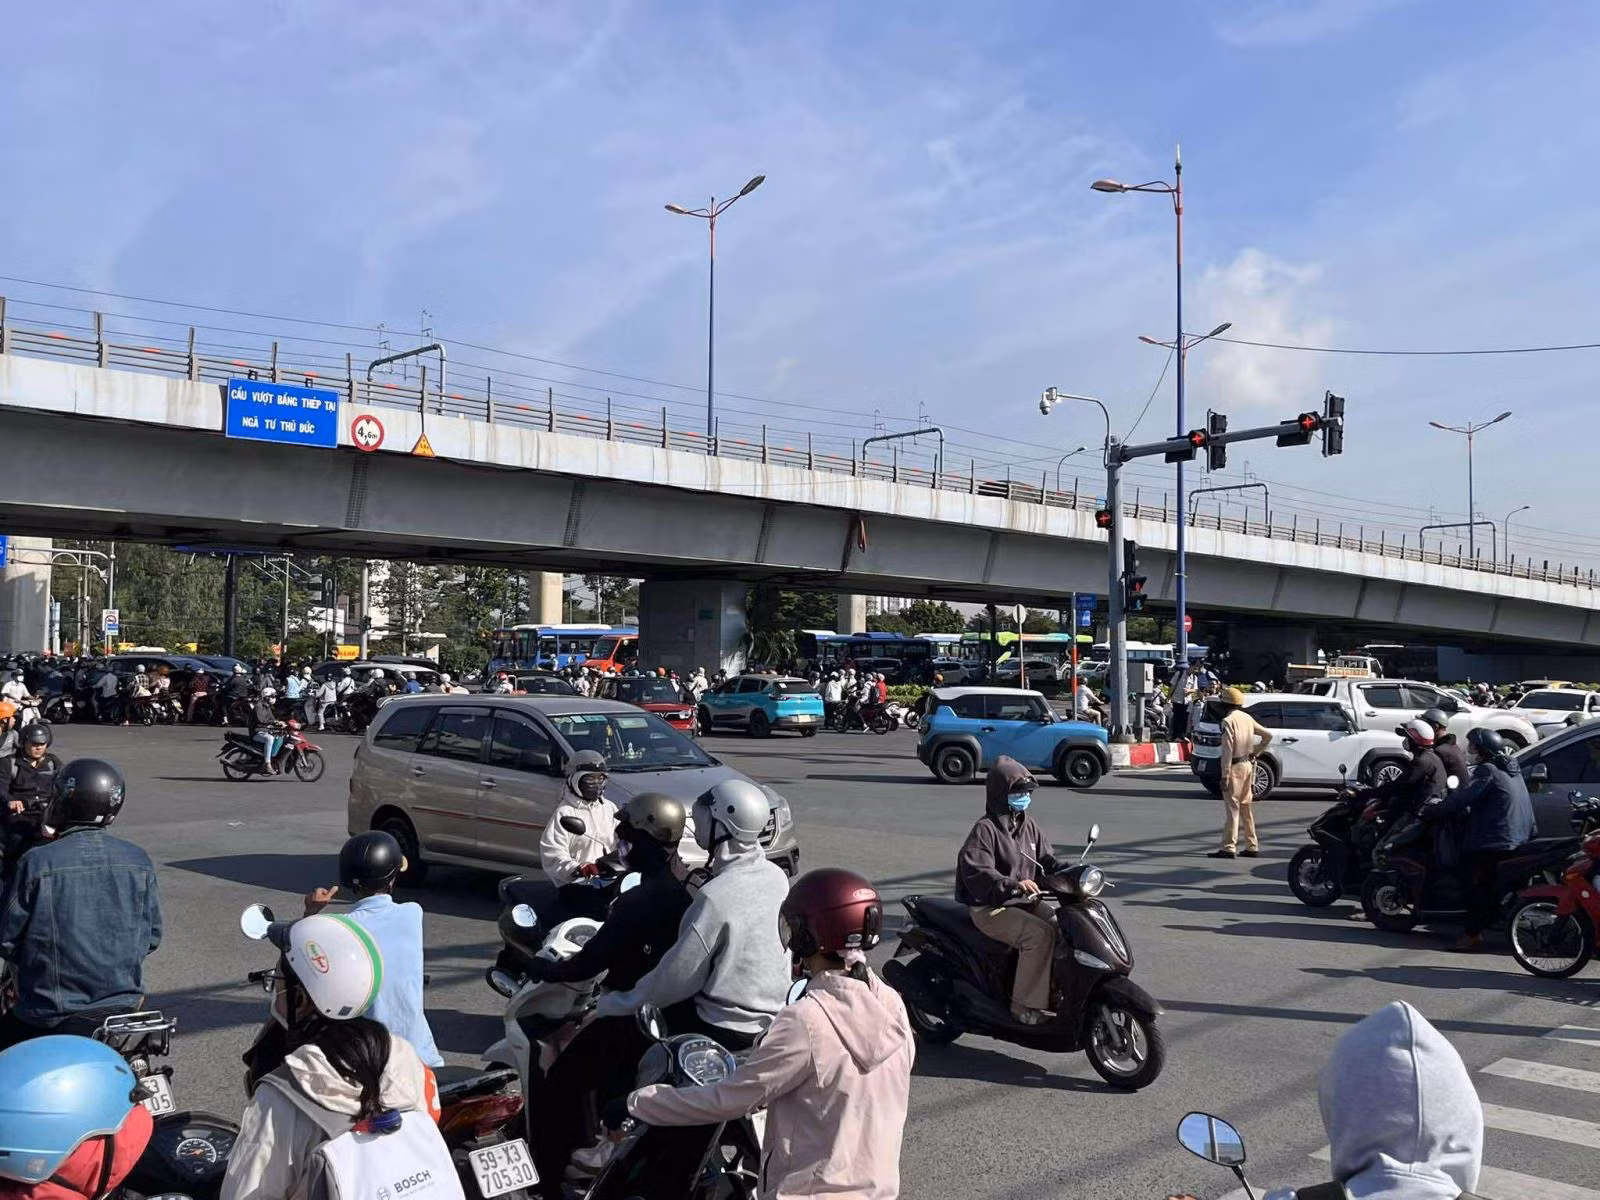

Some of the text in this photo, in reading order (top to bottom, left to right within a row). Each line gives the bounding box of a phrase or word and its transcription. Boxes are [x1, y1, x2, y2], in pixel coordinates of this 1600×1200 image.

[301, 396, 322, 409] THÉP
[264, 418, 277, 430] TƯ
[478, 1144, 522, 1171] 59-X3
[393, 1169, 432, 1193] BOSCH
[481, 1163, 533, 1194] 705.30
